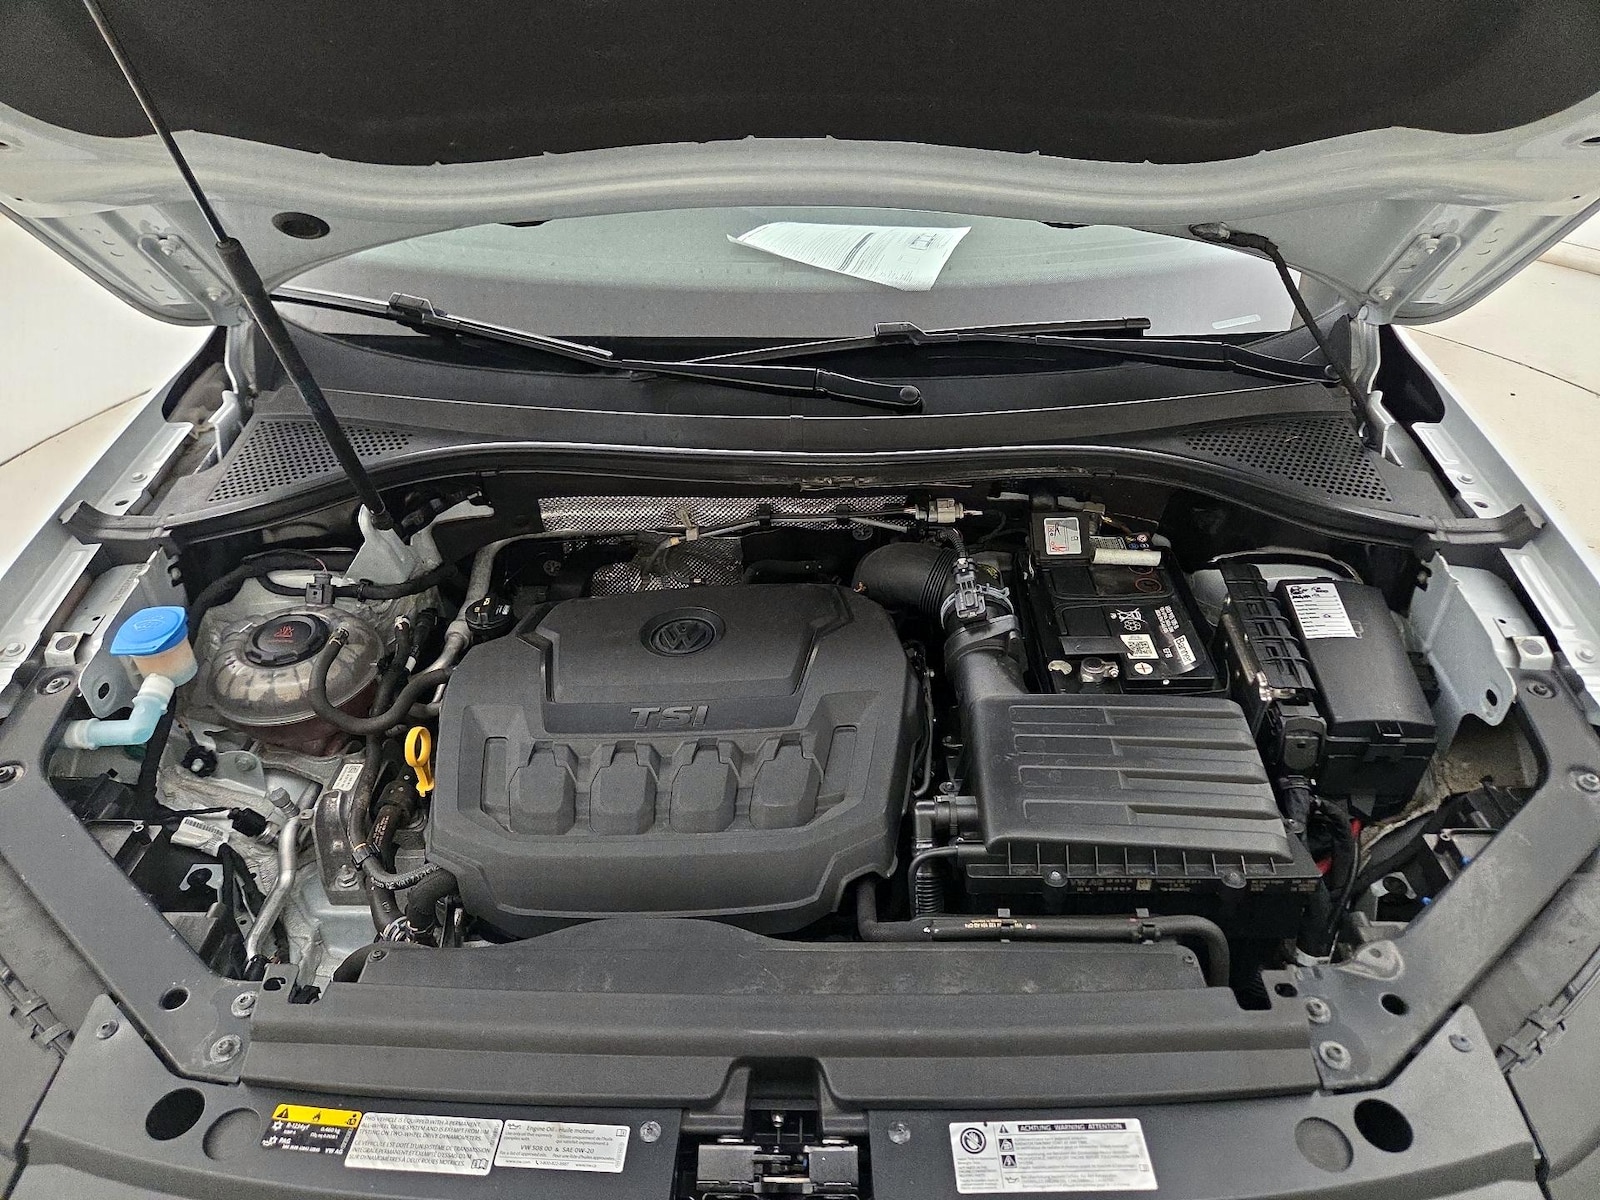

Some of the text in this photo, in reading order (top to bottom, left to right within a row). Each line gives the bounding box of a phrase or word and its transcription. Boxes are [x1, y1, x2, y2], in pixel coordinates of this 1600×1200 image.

[1175, 637, 1193, 664] Banner
[630, 705, 710, 729] TSI
[278, 1136, 291, 1144] PAG
[453, 1145, 490, 1153] TRANSMISSION
